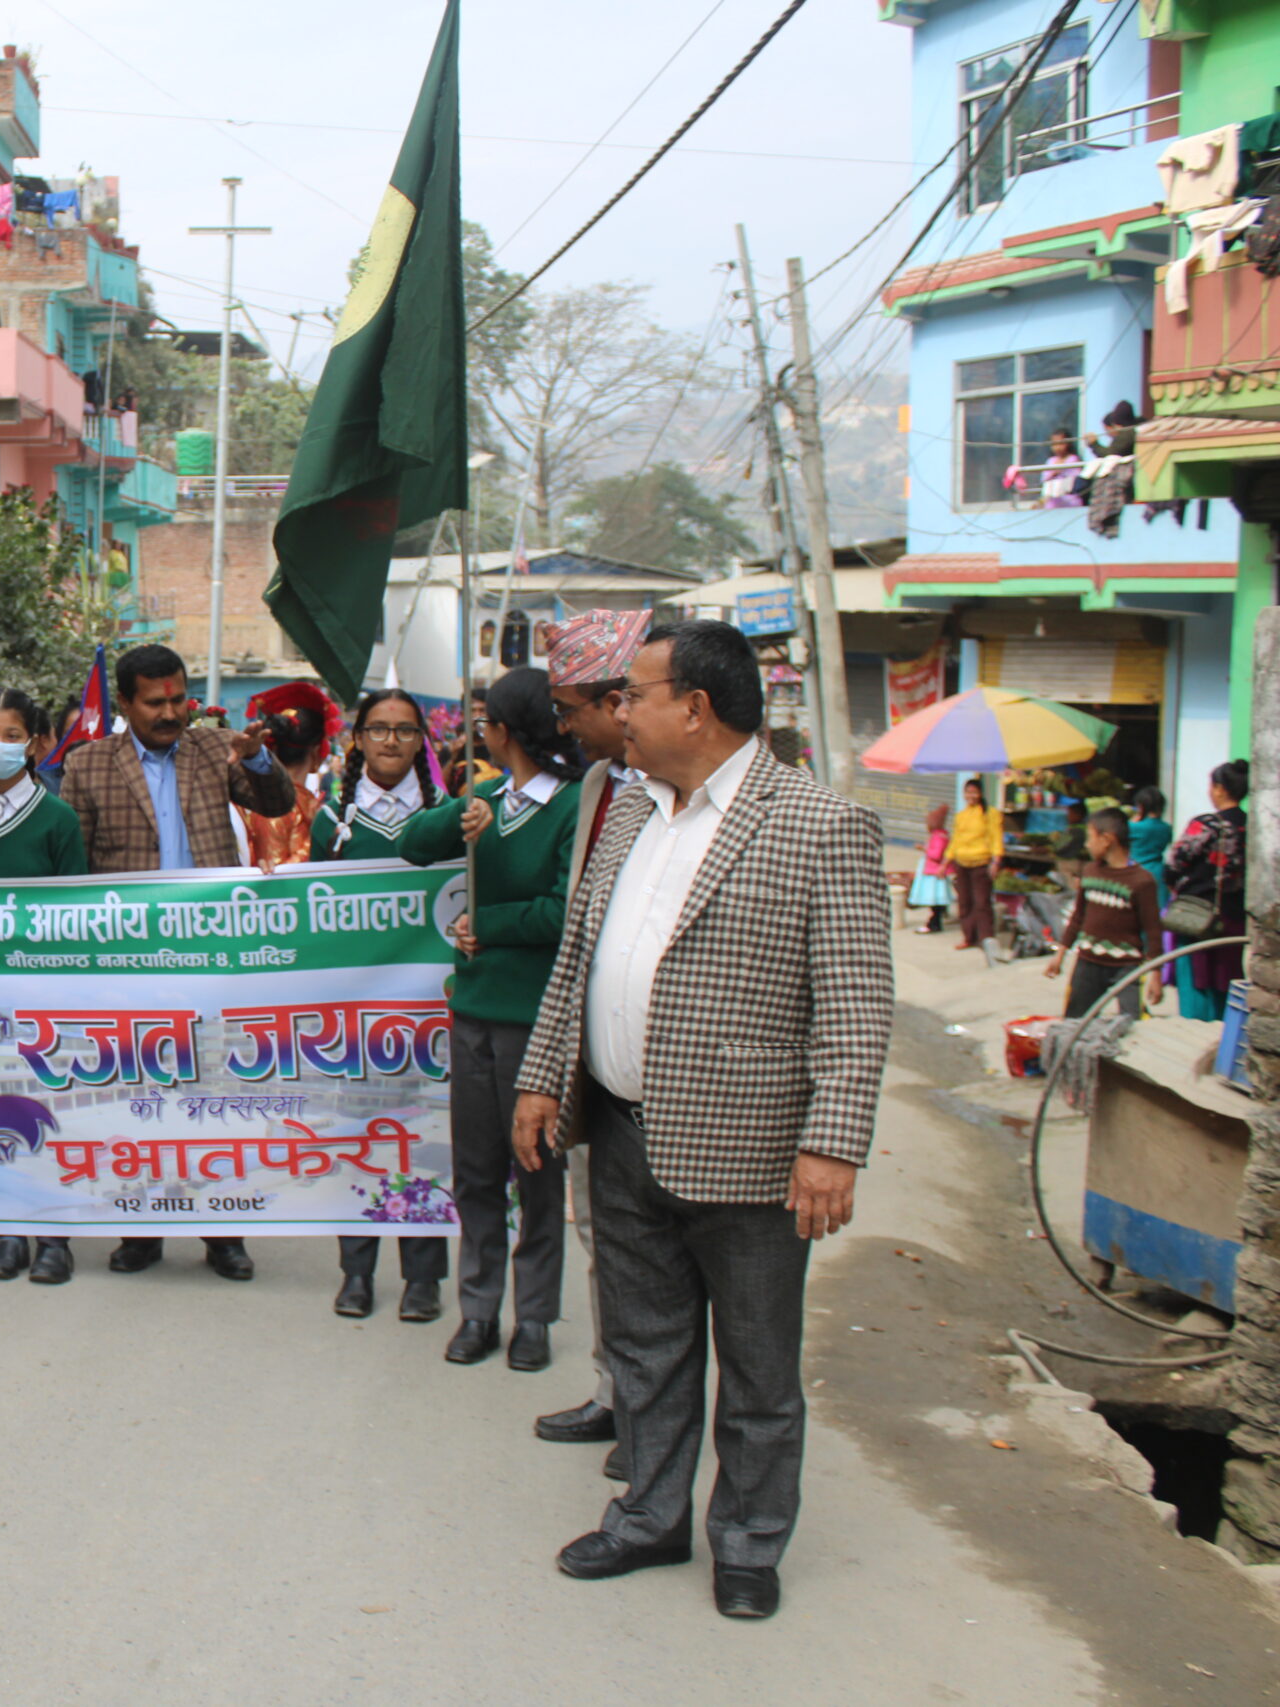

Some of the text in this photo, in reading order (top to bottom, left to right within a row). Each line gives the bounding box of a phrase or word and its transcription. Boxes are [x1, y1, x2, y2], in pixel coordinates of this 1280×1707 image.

[25, 890, 149, 943] आवासीय
[157, 886, 299, 939] माध्यमिक
[307, 881, 428, 934] विद्यालय
[5, 949, 91, 969] नीलकण्ठ
[14, 999, 453, 1089] रजत जयन्त
[129, 1090, 165, 1121] को
[45, 1117, 421, 1184] प्रभातफेरी
[114, 1197, 142, 1213] १२
